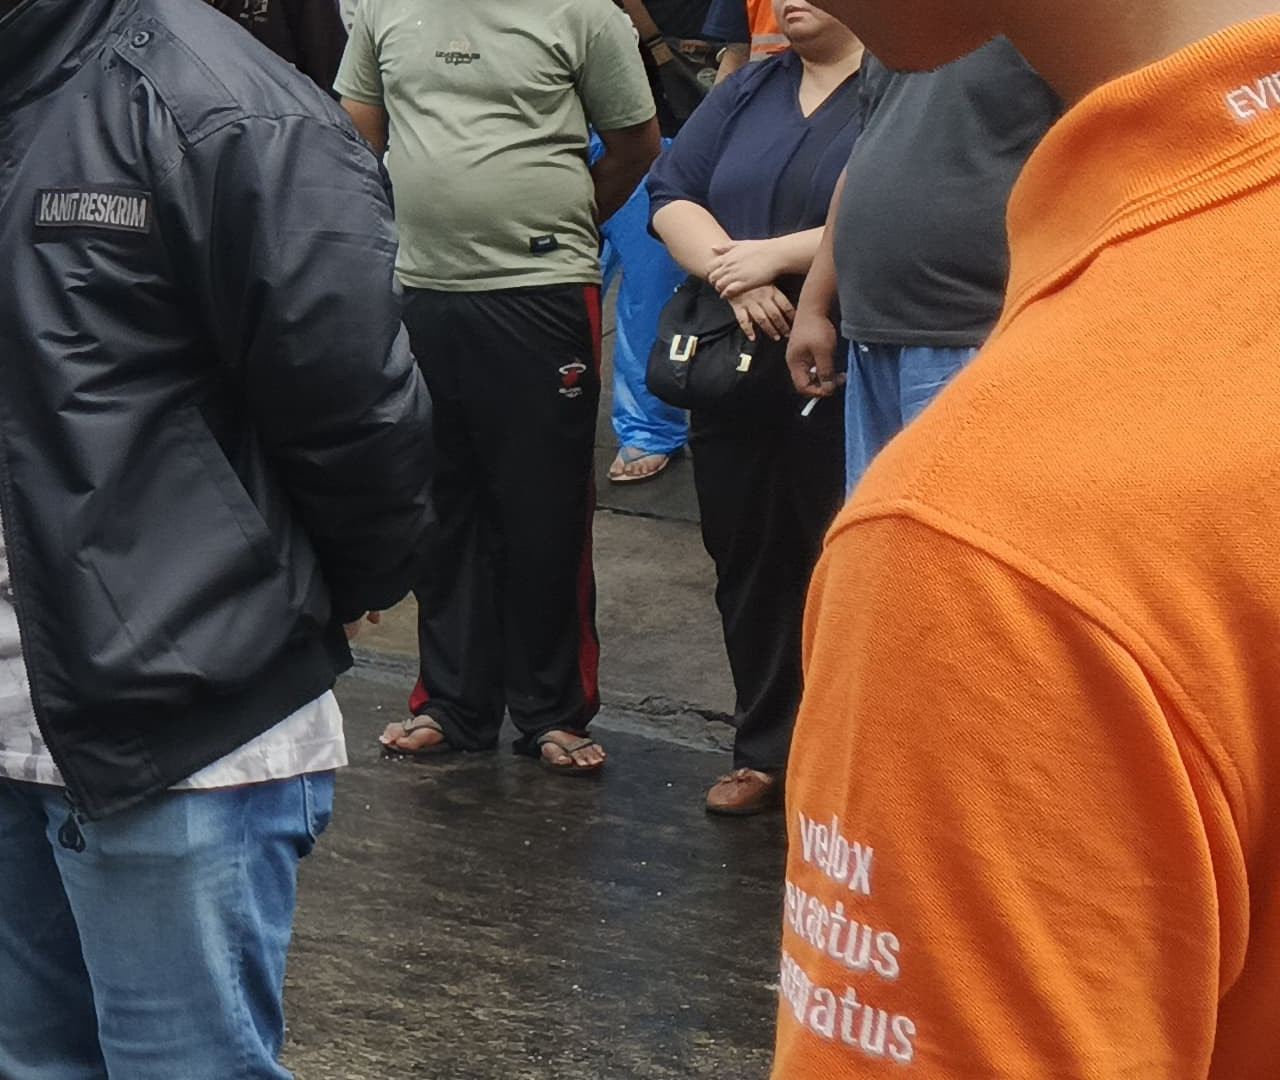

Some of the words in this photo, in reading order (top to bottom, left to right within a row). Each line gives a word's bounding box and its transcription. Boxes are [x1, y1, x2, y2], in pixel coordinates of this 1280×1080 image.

[40, 192, 80, 221] KANIT
[78, 192, 147, 227] RESKRIM
[798, 811, 874, 896] velox
